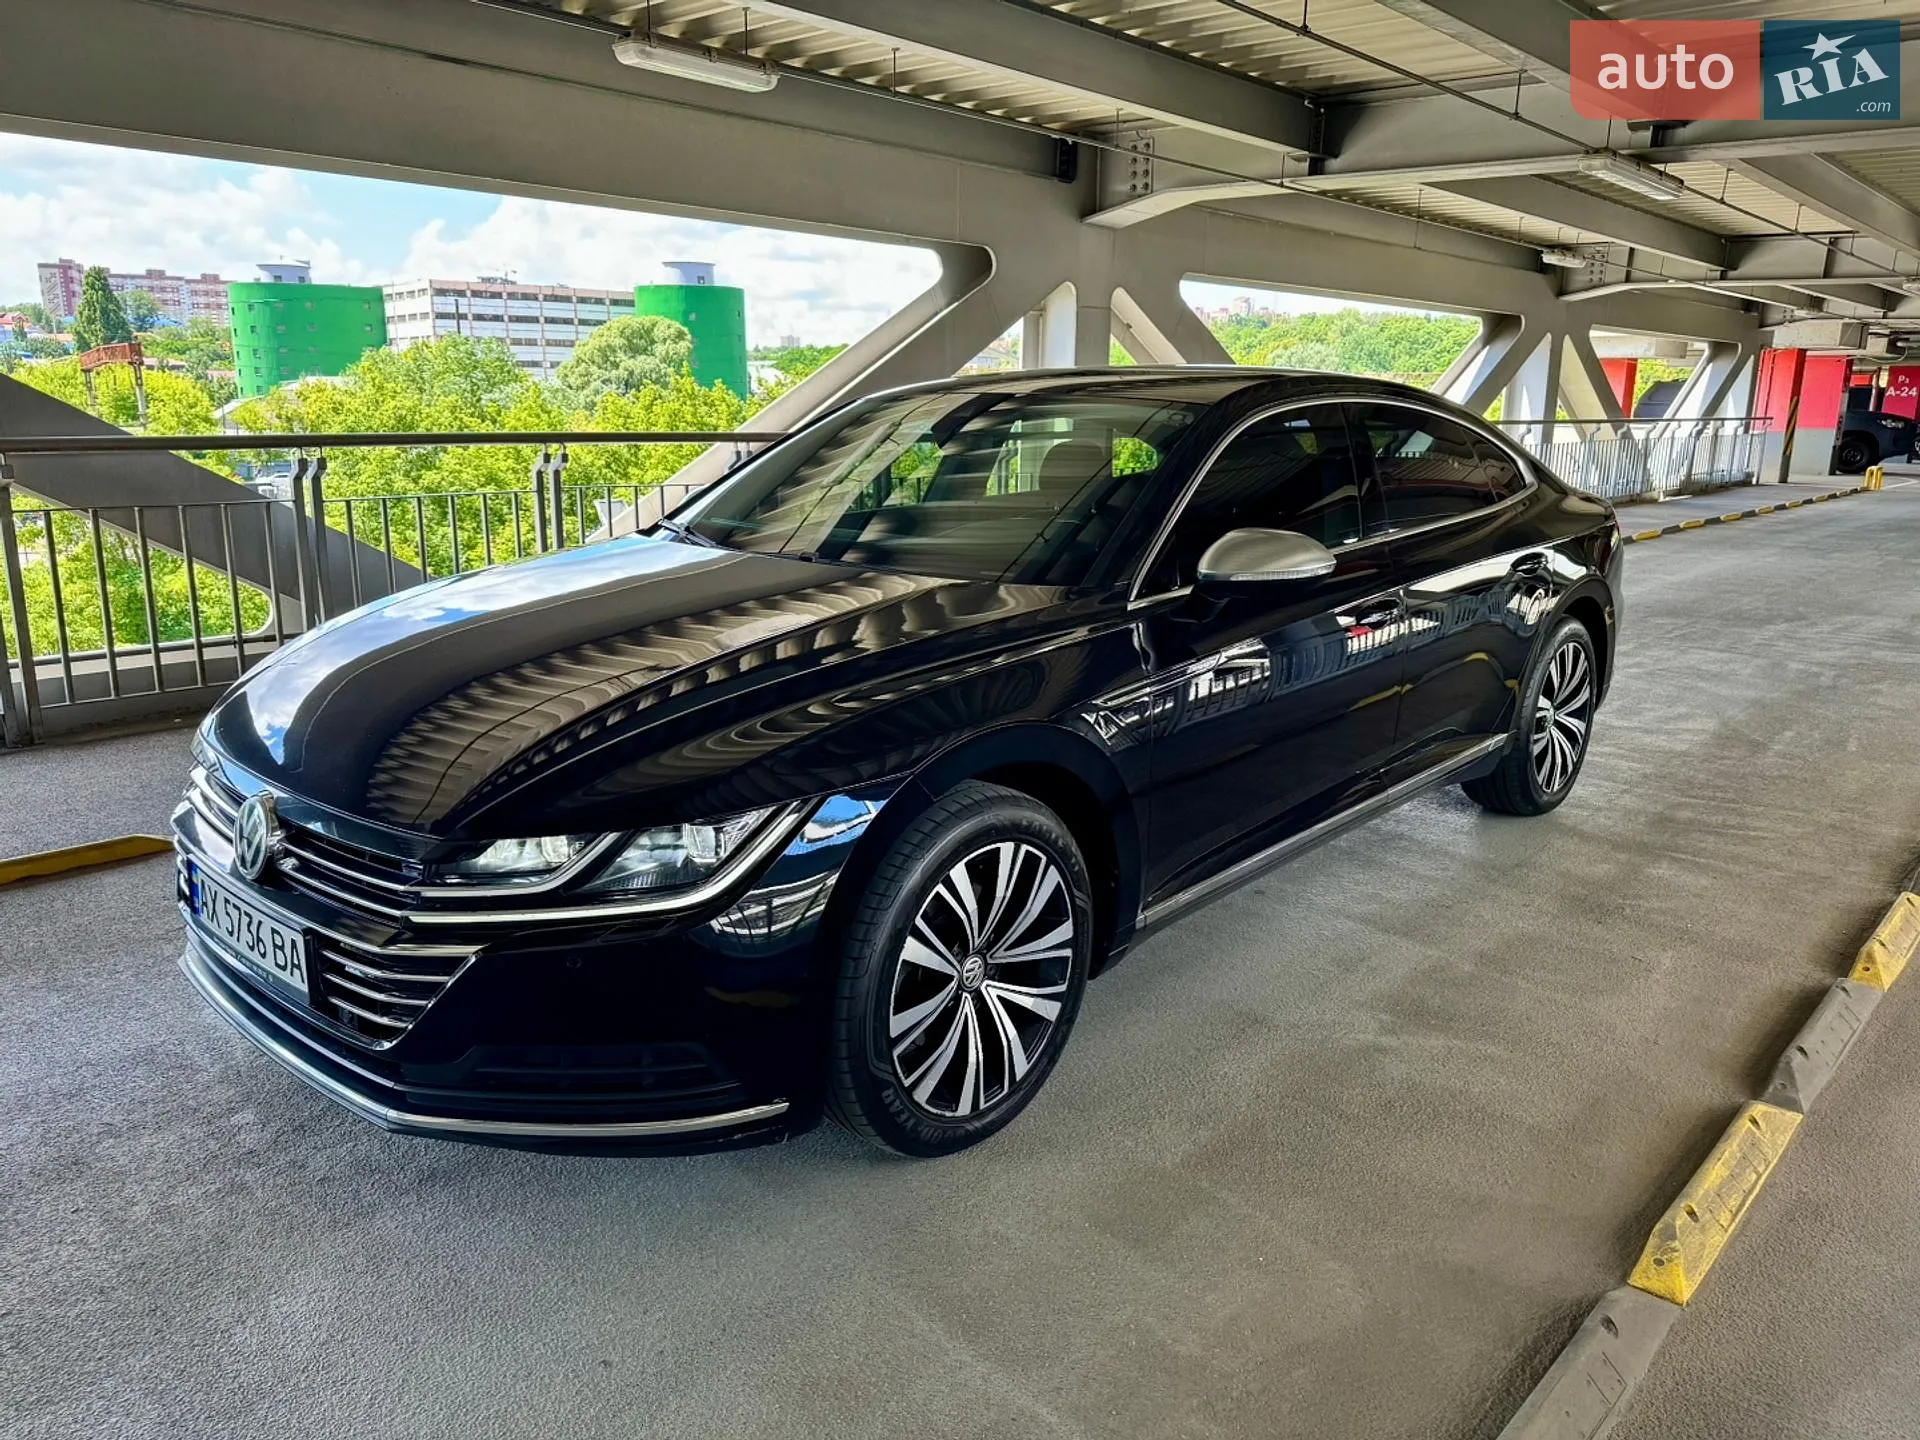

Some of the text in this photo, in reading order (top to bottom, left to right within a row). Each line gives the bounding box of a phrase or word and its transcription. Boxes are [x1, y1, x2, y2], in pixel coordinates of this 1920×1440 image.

[1886, 386, 1917, 396] A-24
[200, 879, 221, 929] AX
[224, 897, 266, 959] 5736
[271, 926, 305, 984] BA
